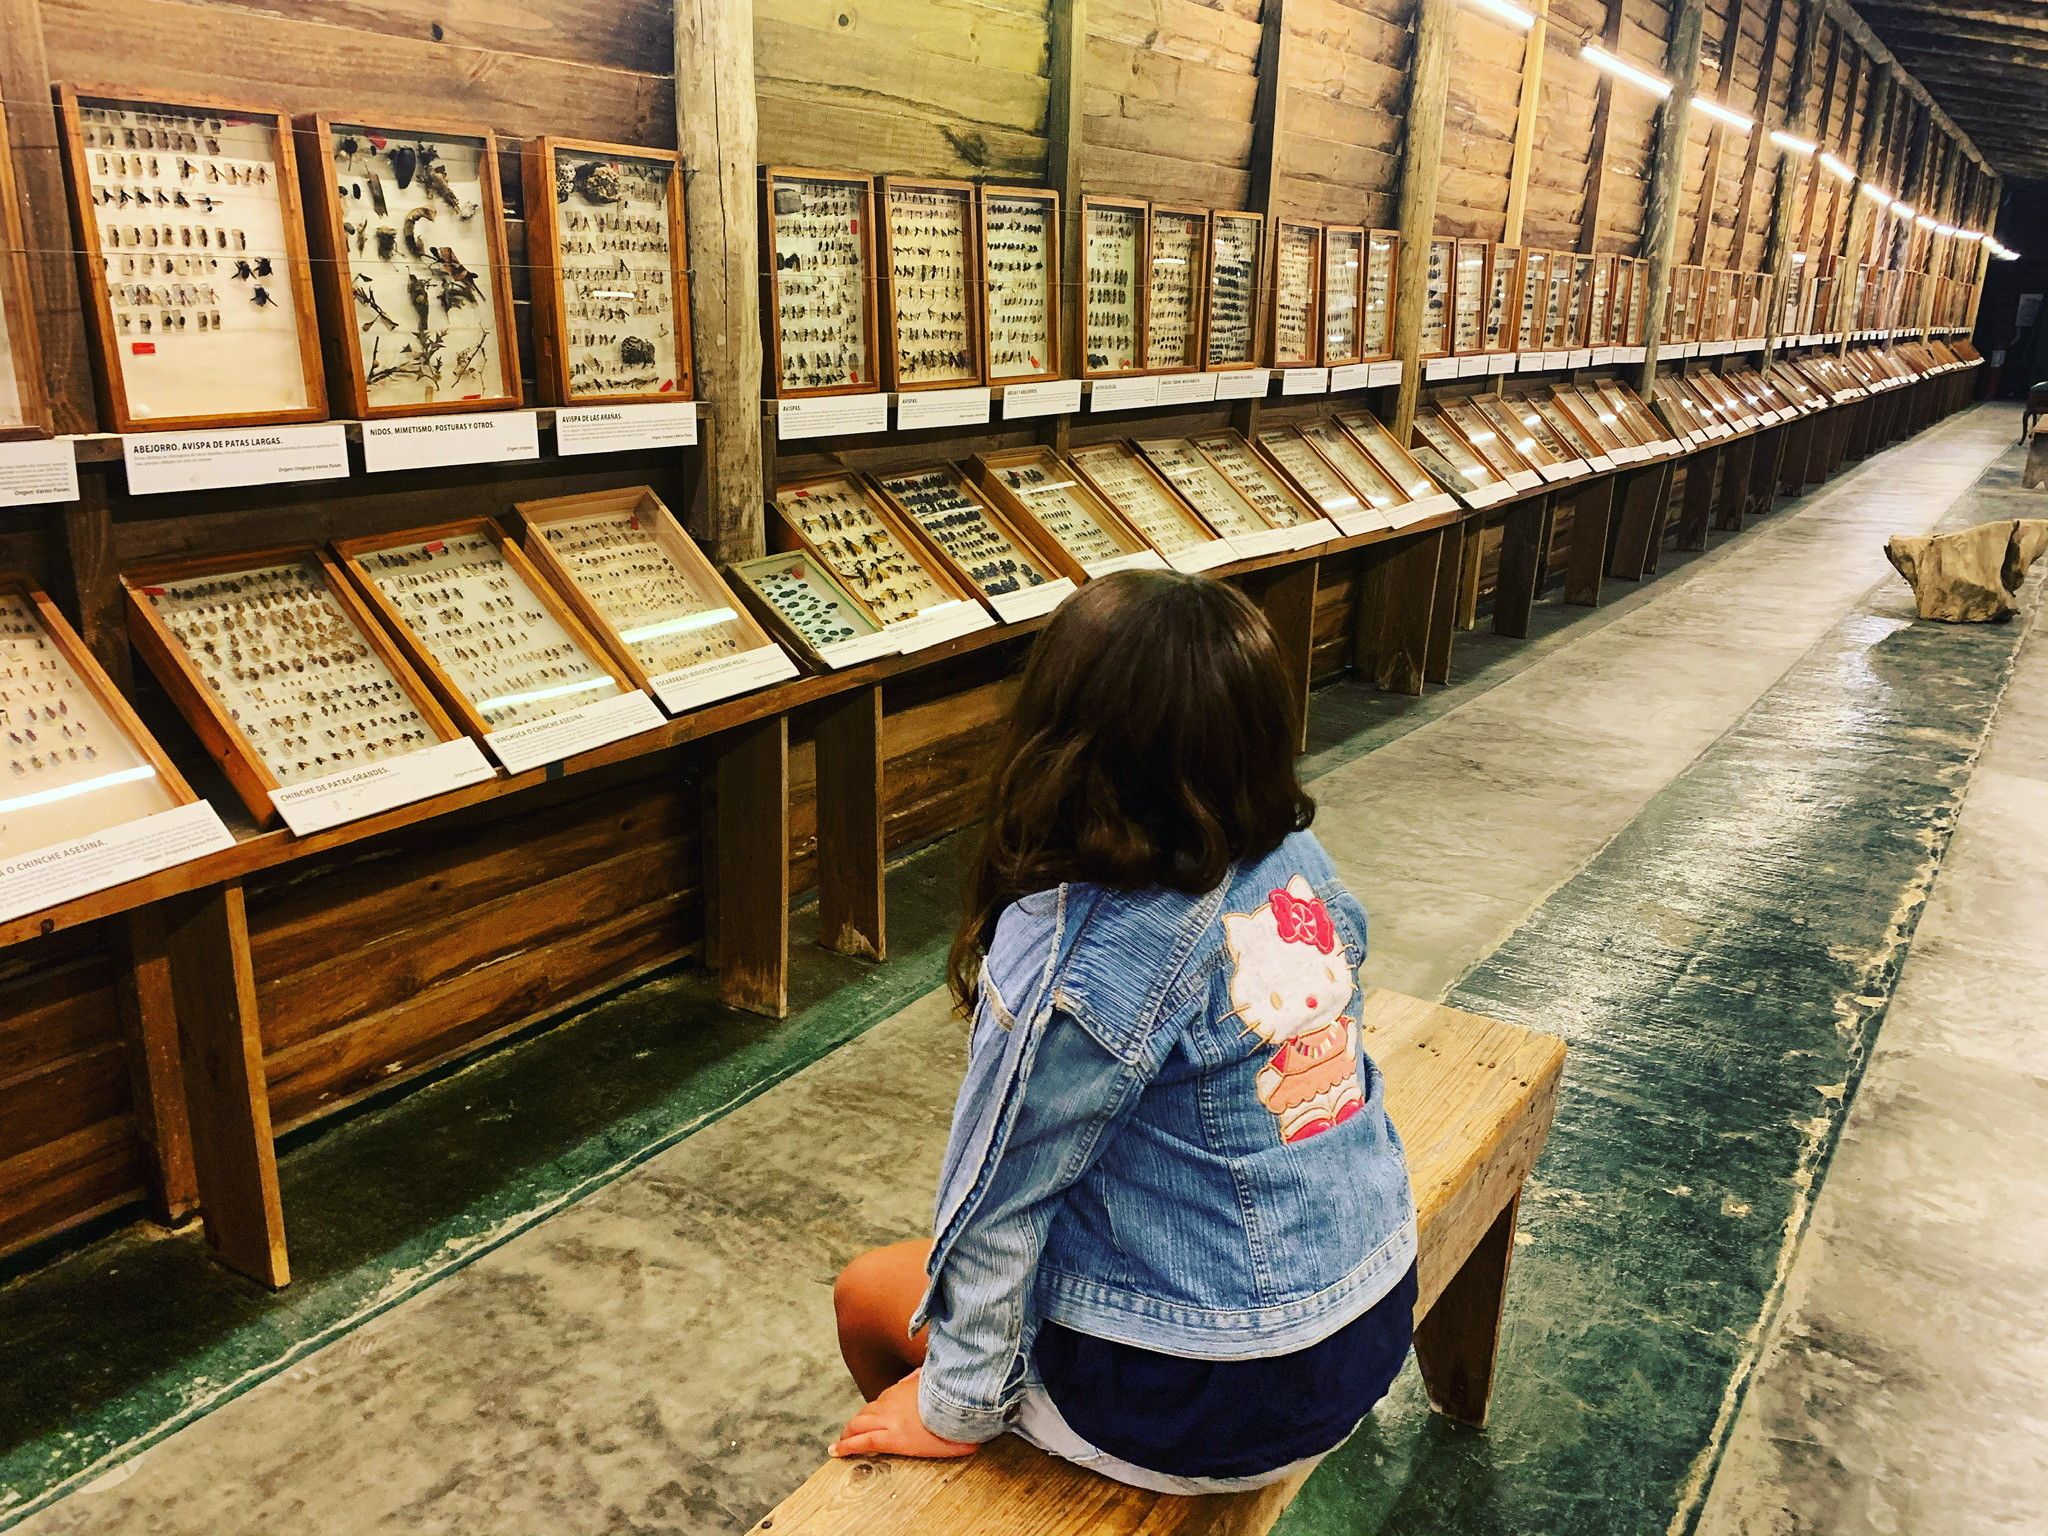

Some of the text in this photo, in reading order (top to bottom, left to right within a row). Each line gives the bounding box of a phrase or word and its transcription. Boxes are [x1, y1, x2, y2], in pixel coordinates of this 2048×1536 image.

[435, 423, 467, 432] POSTURAS
[473, 421, 495, 430] OTROS.
[562, 414, 582, 423] AVISPA
[133, 437, 283, 454] ABEJORRO. AVISPA DE PATAS LARGAS.
[494, 730, 526, 744] VINCHUCA
[533, 719, 560, 733] CHINCHE
[280, 786, 315, 802] CHINCHE
[315, 784, 328, 793] DE
[328, 777, 353, 790] PATAS
[353, 767, 390, 782] GRANDES.
[16, 852, 62, 871] CHINCHE
[64, 839, 108, 857] ASESINA.
